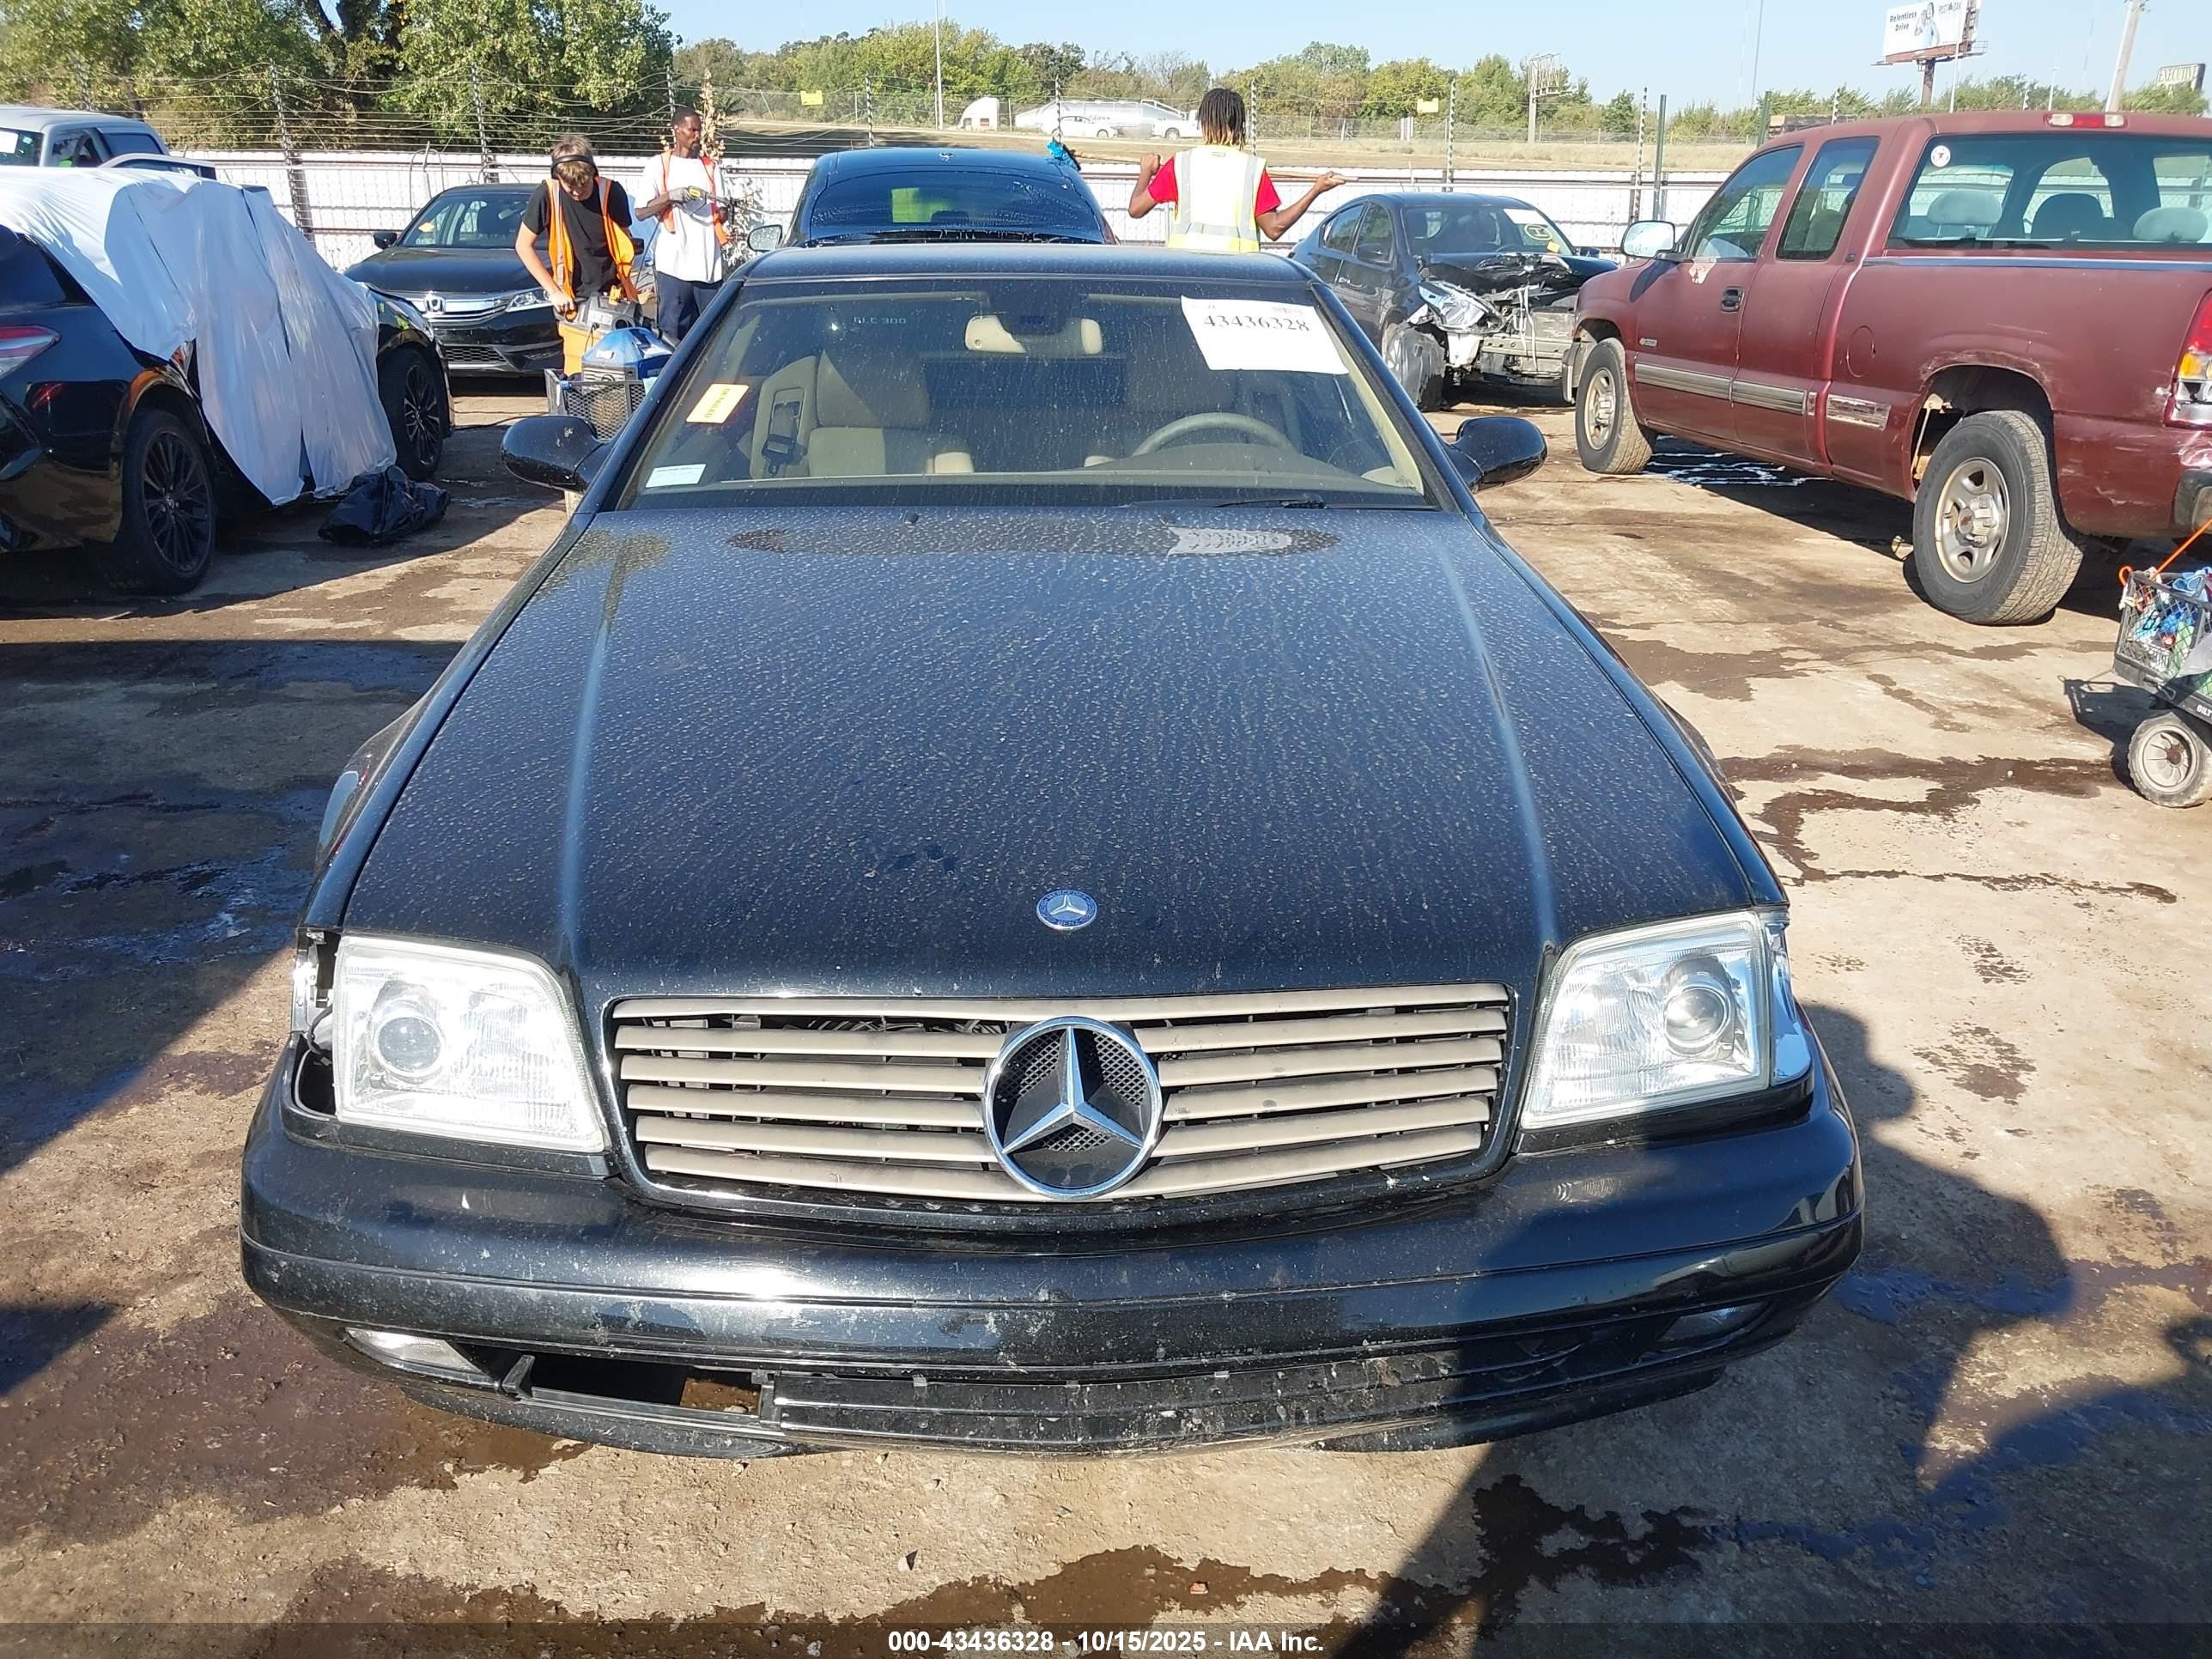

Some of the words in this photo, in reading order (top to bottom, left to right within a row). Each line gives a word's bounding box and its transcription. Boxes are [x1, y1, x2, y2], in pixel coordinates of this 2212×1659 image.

[1889, 11, 1917, 22] Relentless
[1895, 23, 1910, 32] Drive
[1204, 315, 1310, 331] 43436328
